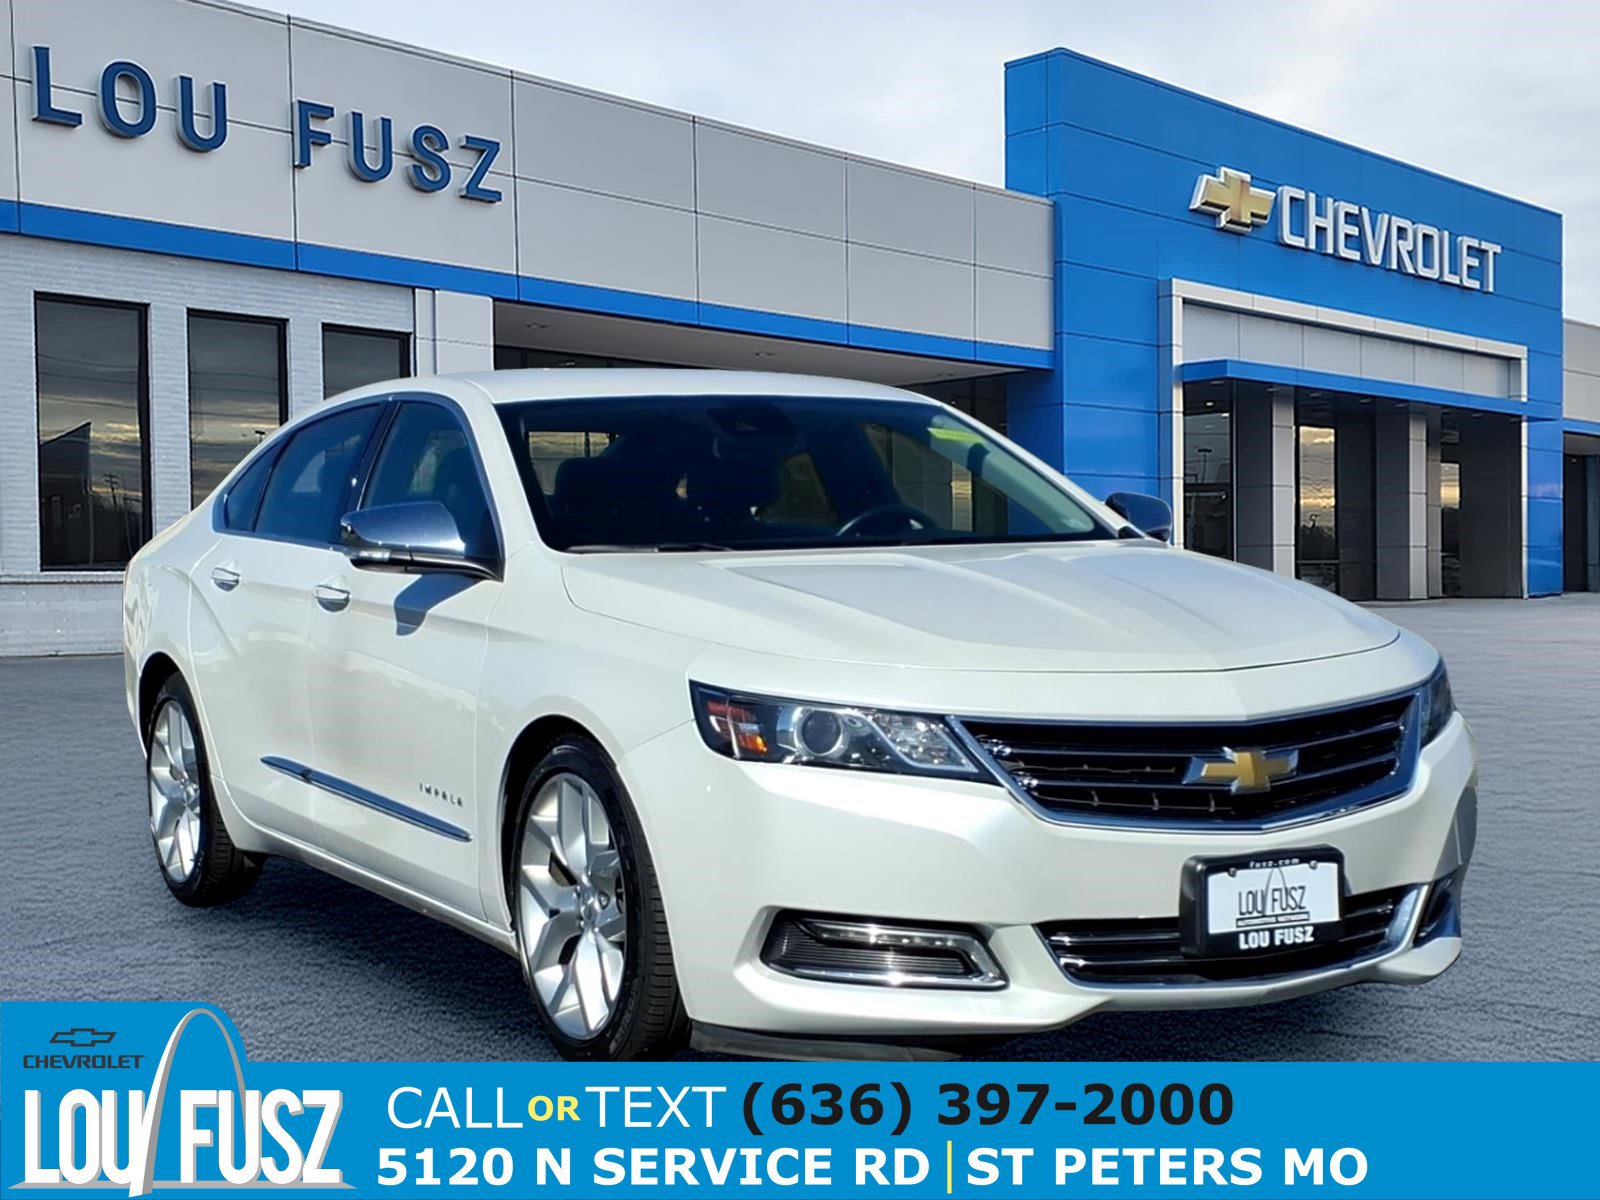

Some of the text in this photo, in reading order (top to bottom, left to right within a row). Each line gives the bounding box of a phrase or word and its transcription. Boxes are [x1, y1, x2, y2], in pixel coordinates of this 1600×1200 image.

[31, 45, 502, 204] LOU FUSZ
[1277, 185, 1502, 293] CHEVROLET
[1249, 858, 1300, 868] fusz.com
[1238, 885, 1307, 916] LOU FUSZ
[1239, 926, 1314, 950] LOU FUSZ
